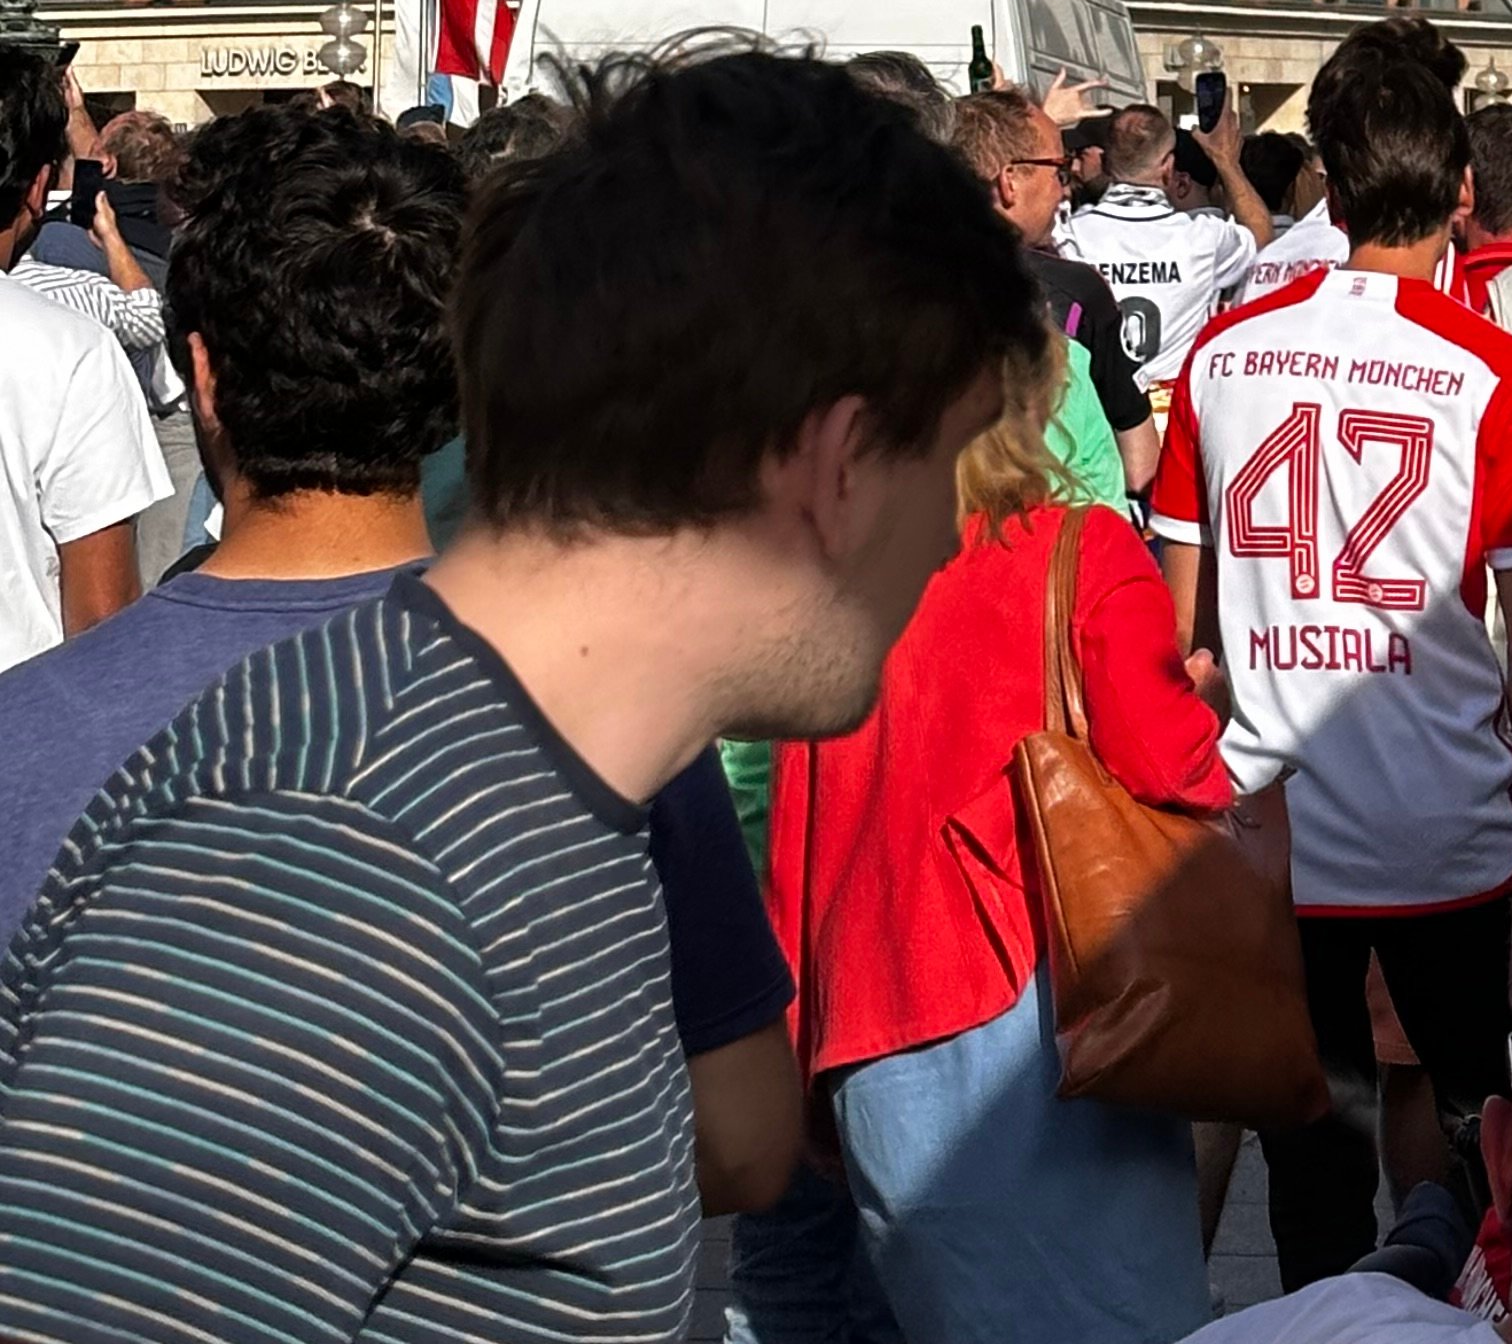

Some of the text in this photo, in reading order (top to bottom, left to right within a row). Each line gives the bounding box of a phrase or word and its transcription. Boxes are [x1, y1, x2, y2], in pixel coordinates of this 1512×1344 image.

[201, 47, 297, 77] LUDWIG
[1099, 261, 1182, 285] ENZEMA
[1209, 353, 1233, 379] FC
[1243, 350, 1339, 379] BAYERN
[1225, 401, 1435, 612] 42
[1249, 624, 1414, 675] MUSIALA
